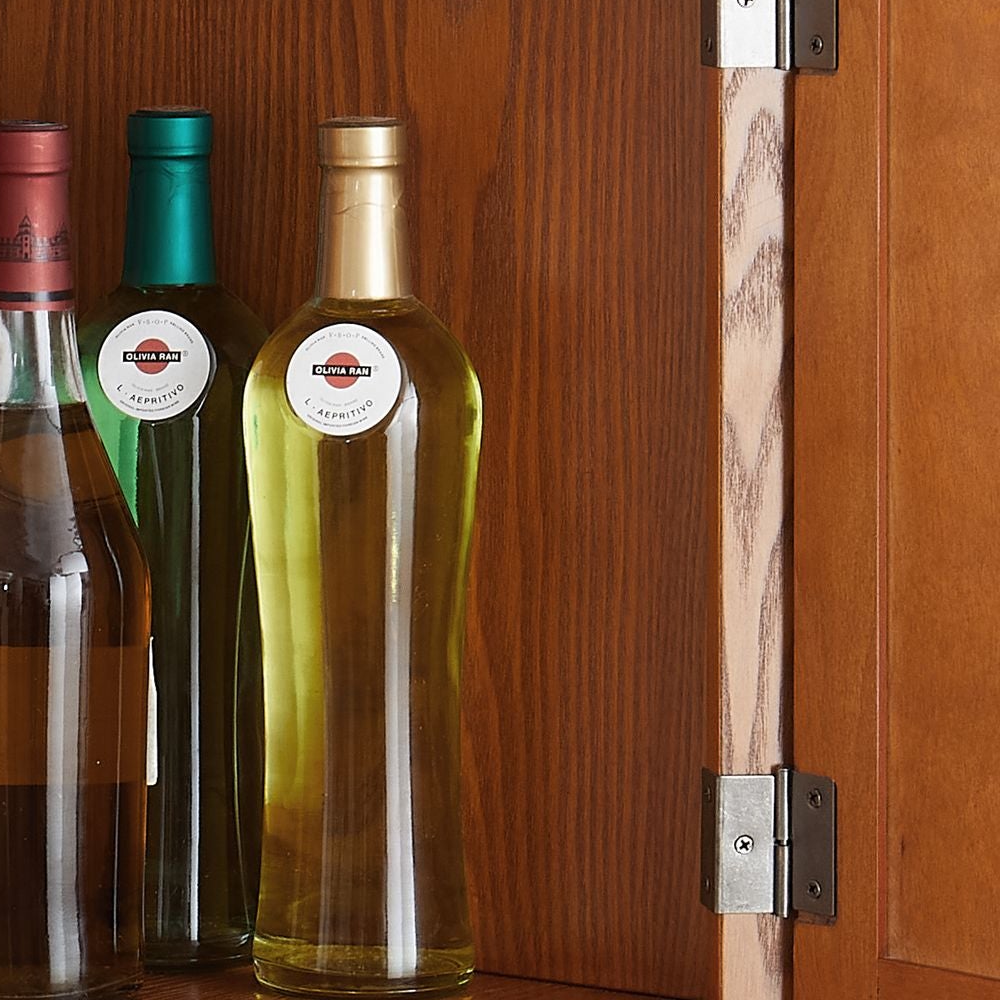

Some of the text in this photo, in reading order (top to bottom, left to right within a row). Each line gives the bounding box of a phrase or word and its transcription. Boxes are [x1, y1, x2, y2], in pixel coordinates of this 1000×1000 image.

[125, 353, 156, 361] OLIVIA
[315, 366, 369, 376] OLIVIA RAN
[129, 384, 184, 404] AEPRITIVO
[317, 399, 373, 419] AEPRITIVO
